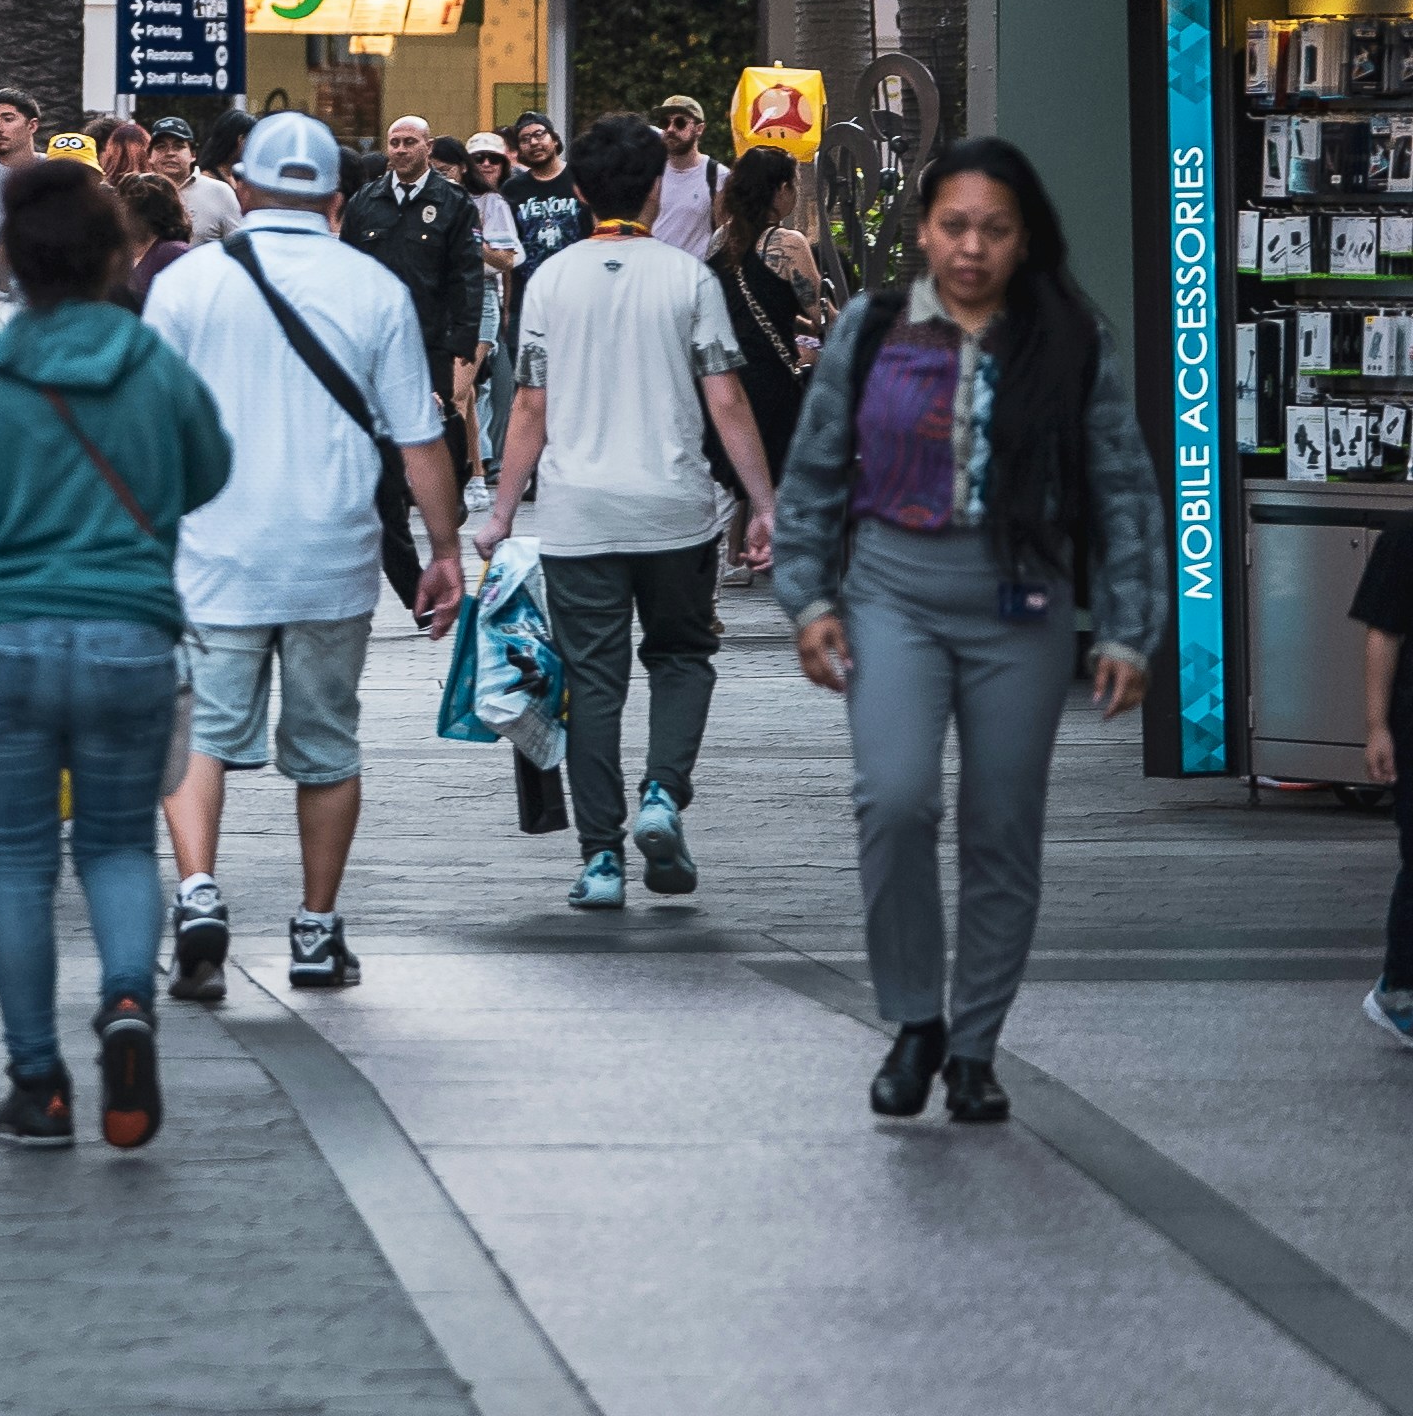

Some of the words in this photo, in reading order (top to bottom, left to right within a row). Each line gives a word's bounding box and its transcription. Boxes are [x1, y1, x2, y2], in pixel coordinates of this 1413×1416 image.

[146, 0, 183, 16] Parking
[146, 25, 183, 40] Parking
[146, 48, 194, 62] Restrooms
[146, 72, 176, 86] Sheriff
[181, 72, 213, 87] Security
[518, 196, 579, 221] VENOM
[1173, 146, 1210, 432] ACCESSORIES
[1181, 445, 1213, 599] MOBILE
